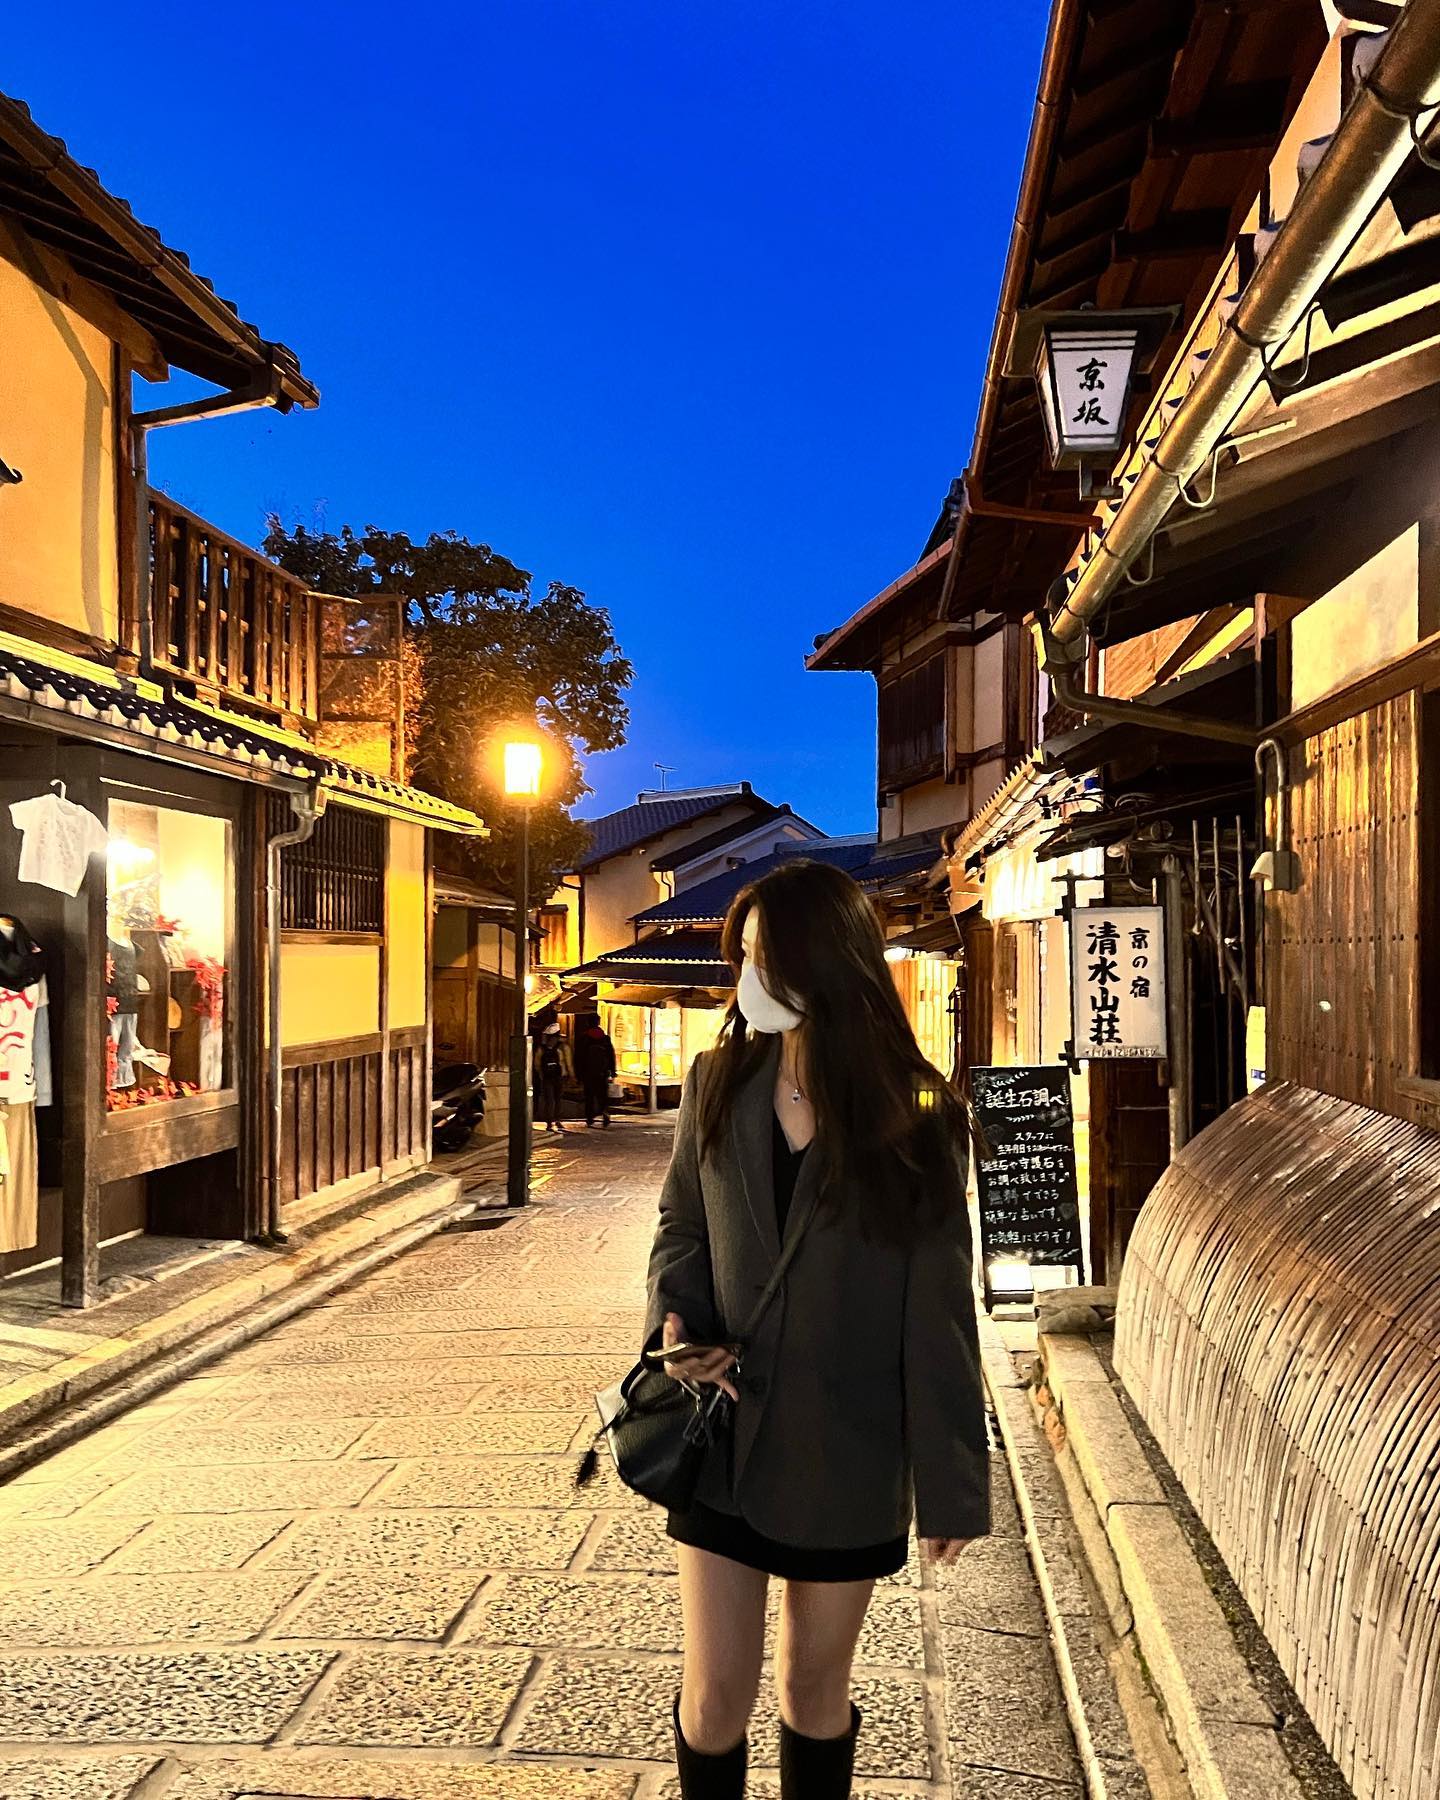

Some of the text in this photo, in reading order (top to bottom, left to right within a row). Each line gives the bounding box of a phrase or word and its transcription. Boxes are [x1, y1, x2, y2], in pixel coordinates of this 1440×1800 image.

[1072, 357, 1110, 426] 京坂
[1086, 921, 1123, 1047] 清水山荘
[1128, 927, 1151, 999] 京の宿
[985, 1088, 1066, 1109] 誕生石調べ
[1014, 1131, 1055, 1141] スタッフに
